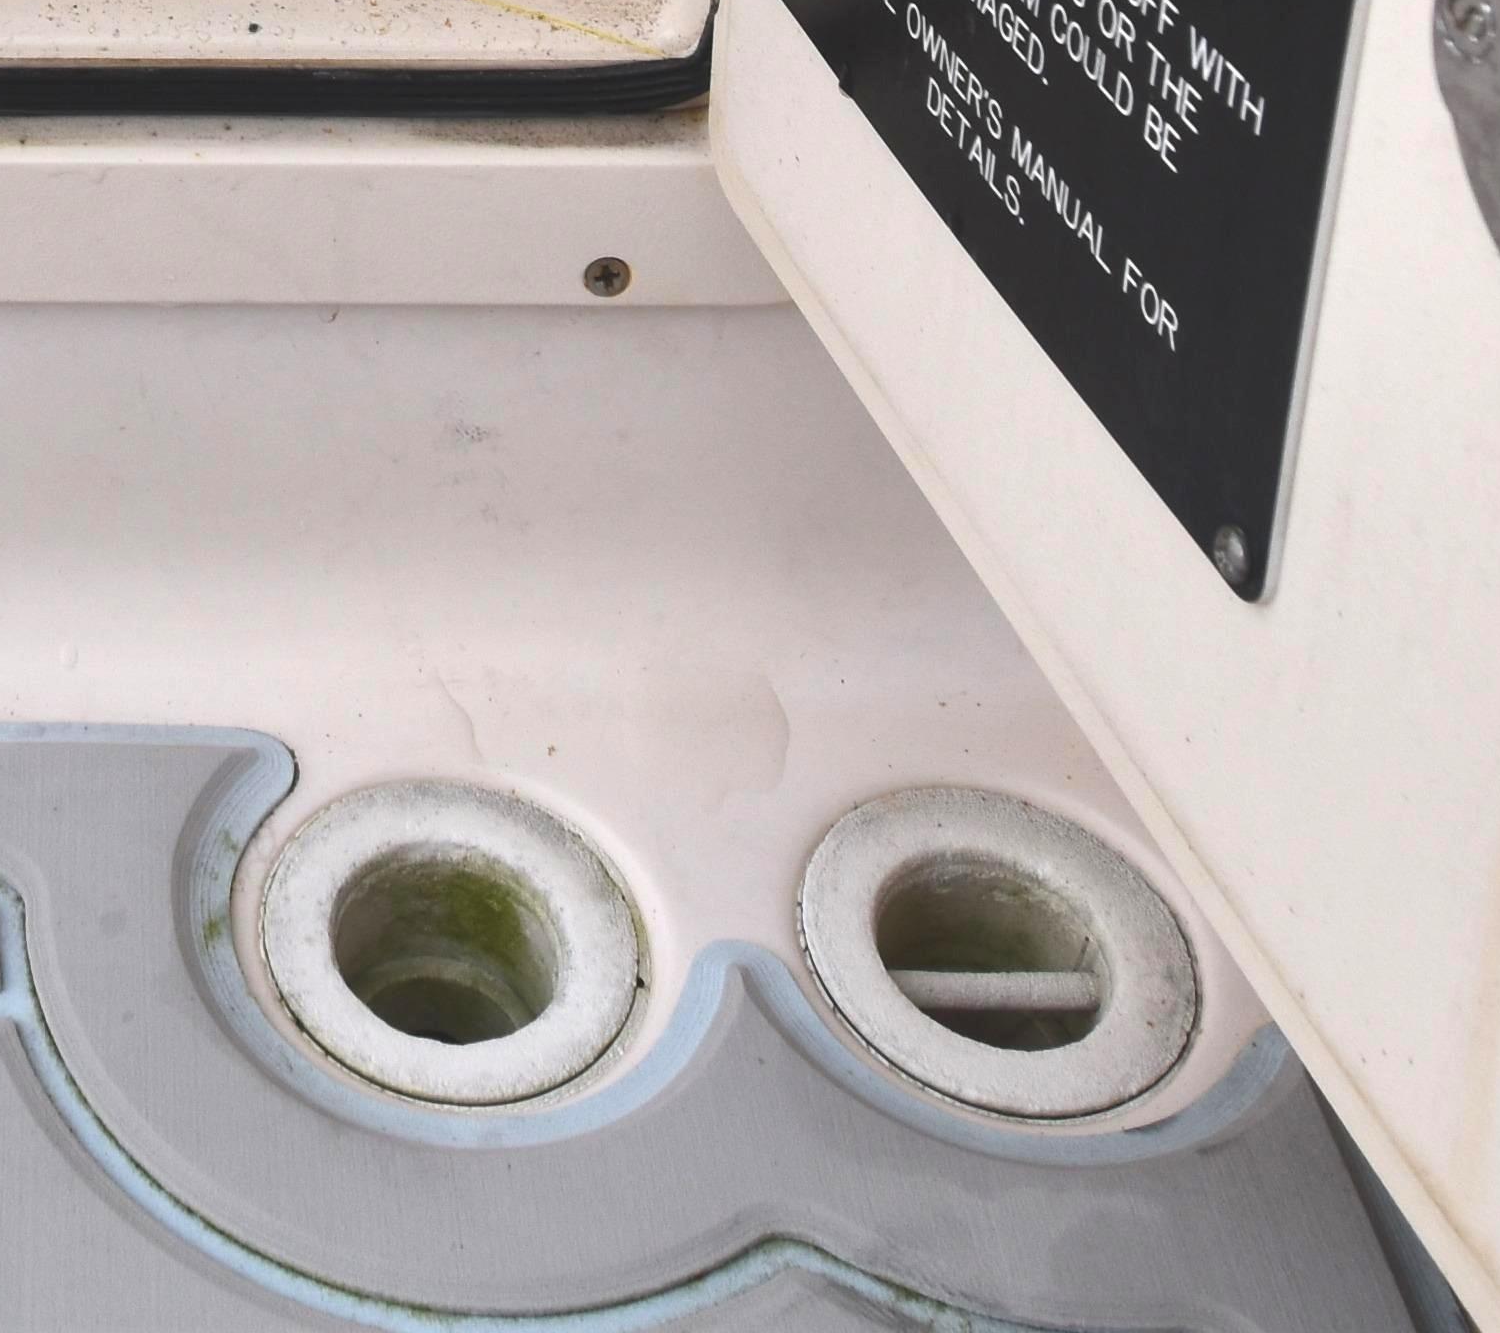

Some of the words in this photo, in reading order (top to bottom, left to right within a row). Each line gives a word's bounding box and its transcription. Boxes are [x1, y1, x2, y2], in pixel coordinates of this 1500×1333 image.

[927, 77, 1025, 226] DETAILS.
[1050, 3, 1134, 117] COULD
[1143, 104, 1182, 173] BE
[1146, 41, 1202, 134] THE
[1190, 25, 1266, 136] WITH
[906, 2, 1003, 140] OWNER'S
[1012, 125, 1112, 275] MANUAL
[1122, 258, 1179, 352] FOR
